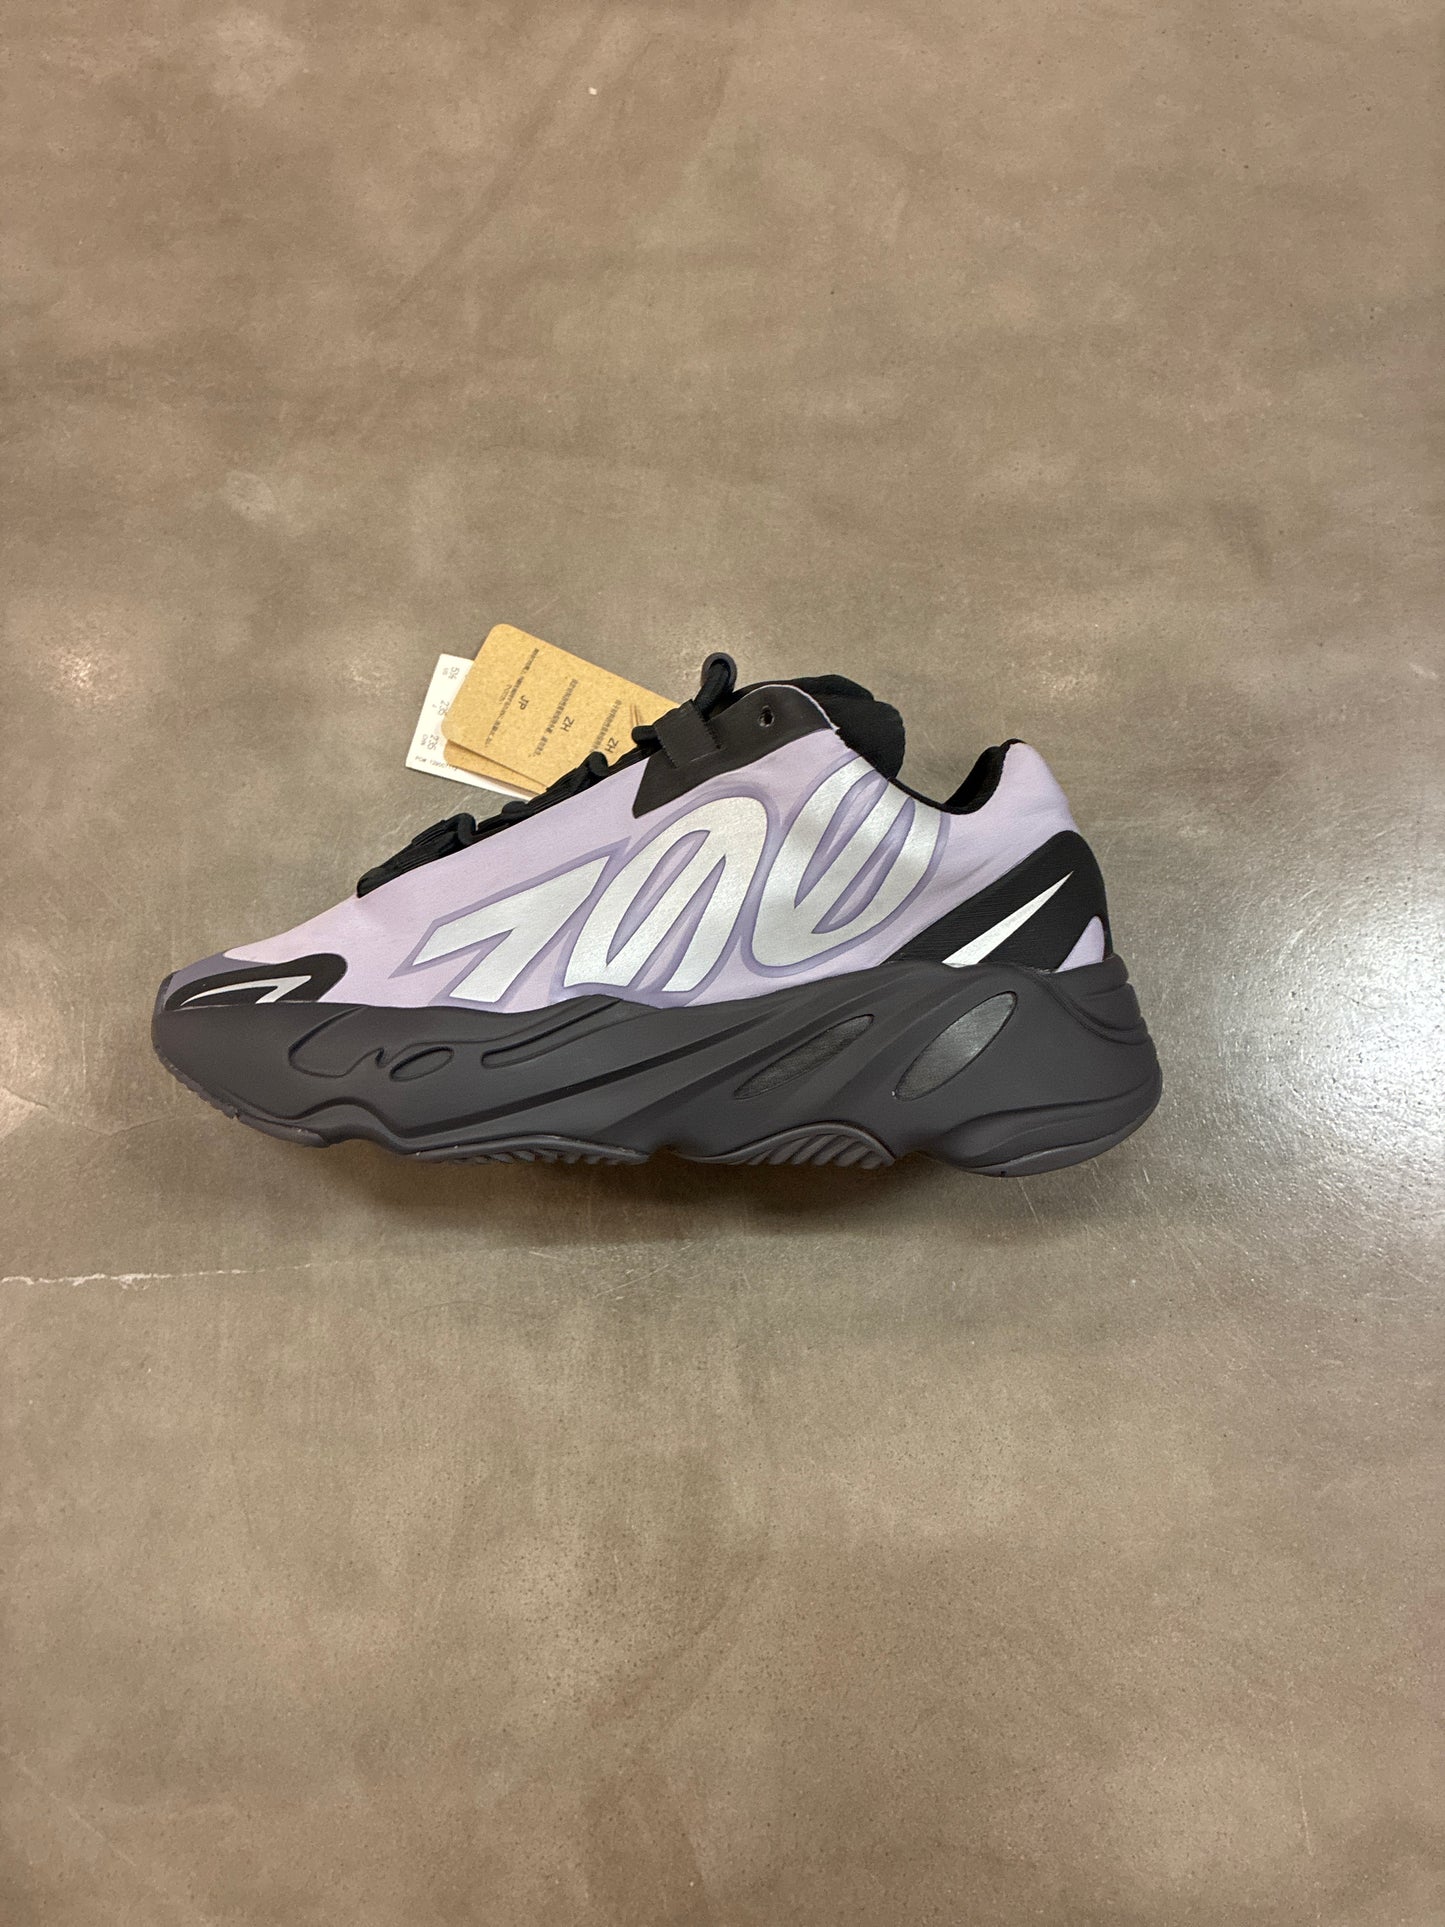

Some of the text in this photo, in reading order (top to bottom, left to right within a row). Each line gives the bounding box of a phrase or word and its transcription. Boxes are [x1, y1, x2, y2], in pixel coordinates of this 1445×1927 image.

[518, 695, 530, 711] JP
[560, 715, 575, 733] ZH
[604, 736, 619, 754] ZH
